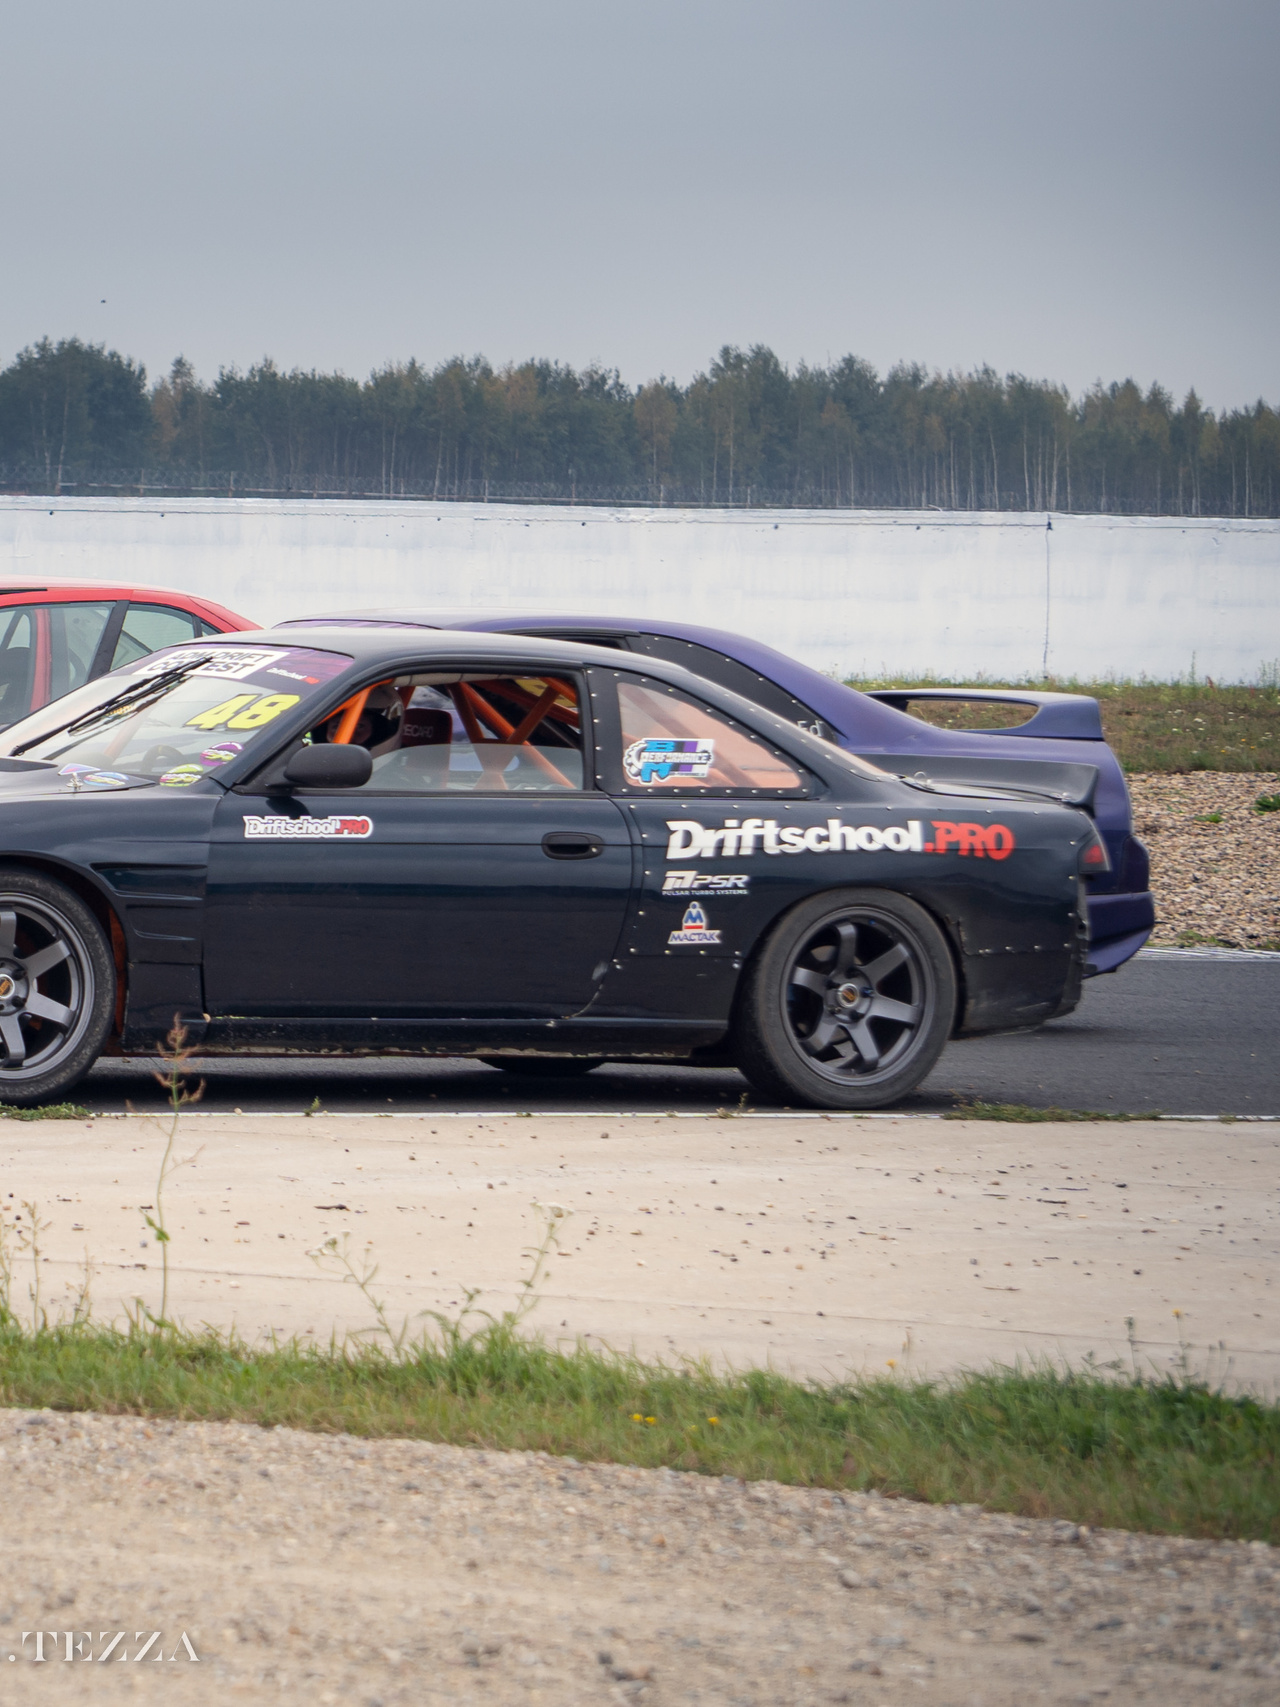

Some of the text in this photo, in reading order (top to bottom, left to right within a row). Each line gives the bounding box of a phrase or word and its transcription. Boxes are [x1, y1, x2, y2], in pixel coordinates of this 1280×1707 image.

[214, 651, 274, 663] DRIFT
[147, 661, 255, 674] COEST
[184, 693, 301, 731] 48
